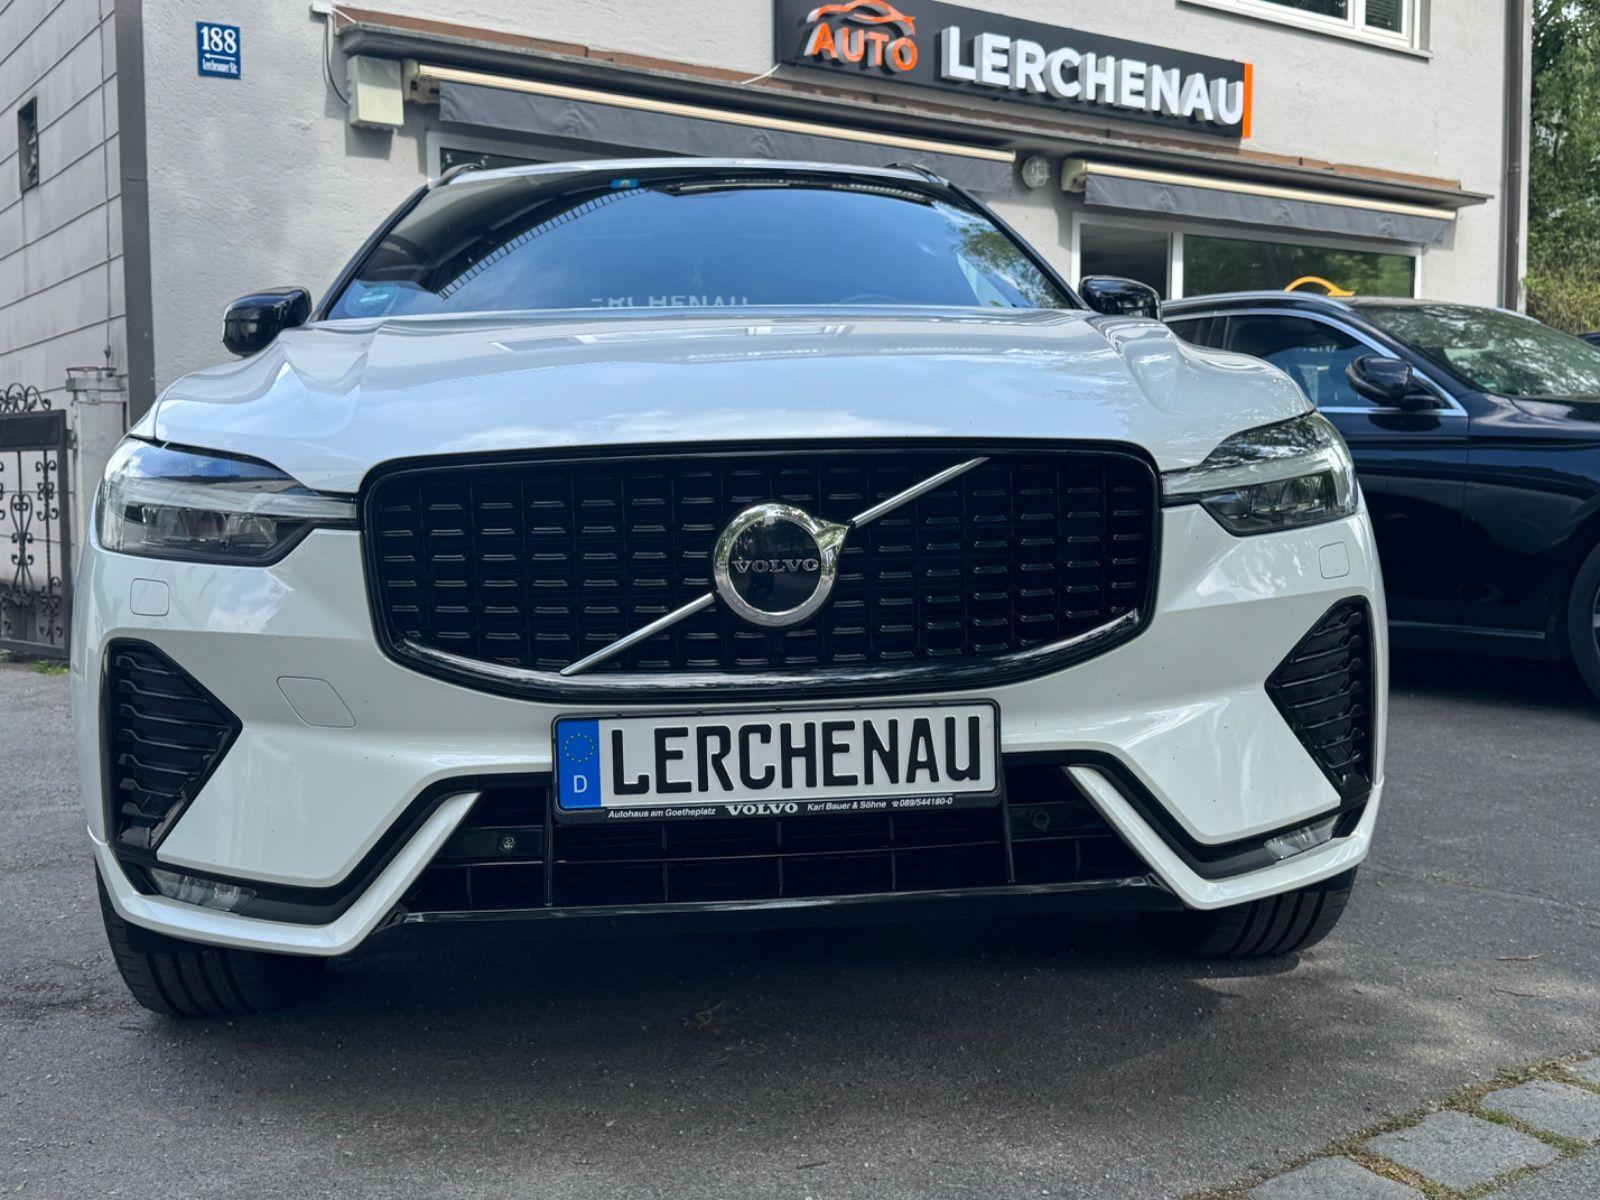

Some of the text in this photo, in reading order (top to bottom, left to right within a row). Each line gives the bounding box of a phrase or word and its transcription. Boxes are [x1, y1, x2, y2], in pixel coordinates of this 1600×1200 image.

[200, 26, 237, 54] 188
[804, 22, 1245, 126] AUTO LERCHENAU
[732, 558, 819, 574] VOLVO
[611, 714, 981, 795] LERCHENAU
[573, 775, 588, 793] D
[607, 810, 649, 819] Autohaus
[650, 809, 664, 817] am
[666, 806, 716, 817] Goetheplatz
[724, 802, 799, 816] VOLVO
[807, 802, 825, 811] Karl
[826, 801, 850, 811] Bauer
[852, 801, 858, 810] &
[860, 800, 887, 810] Söhne
